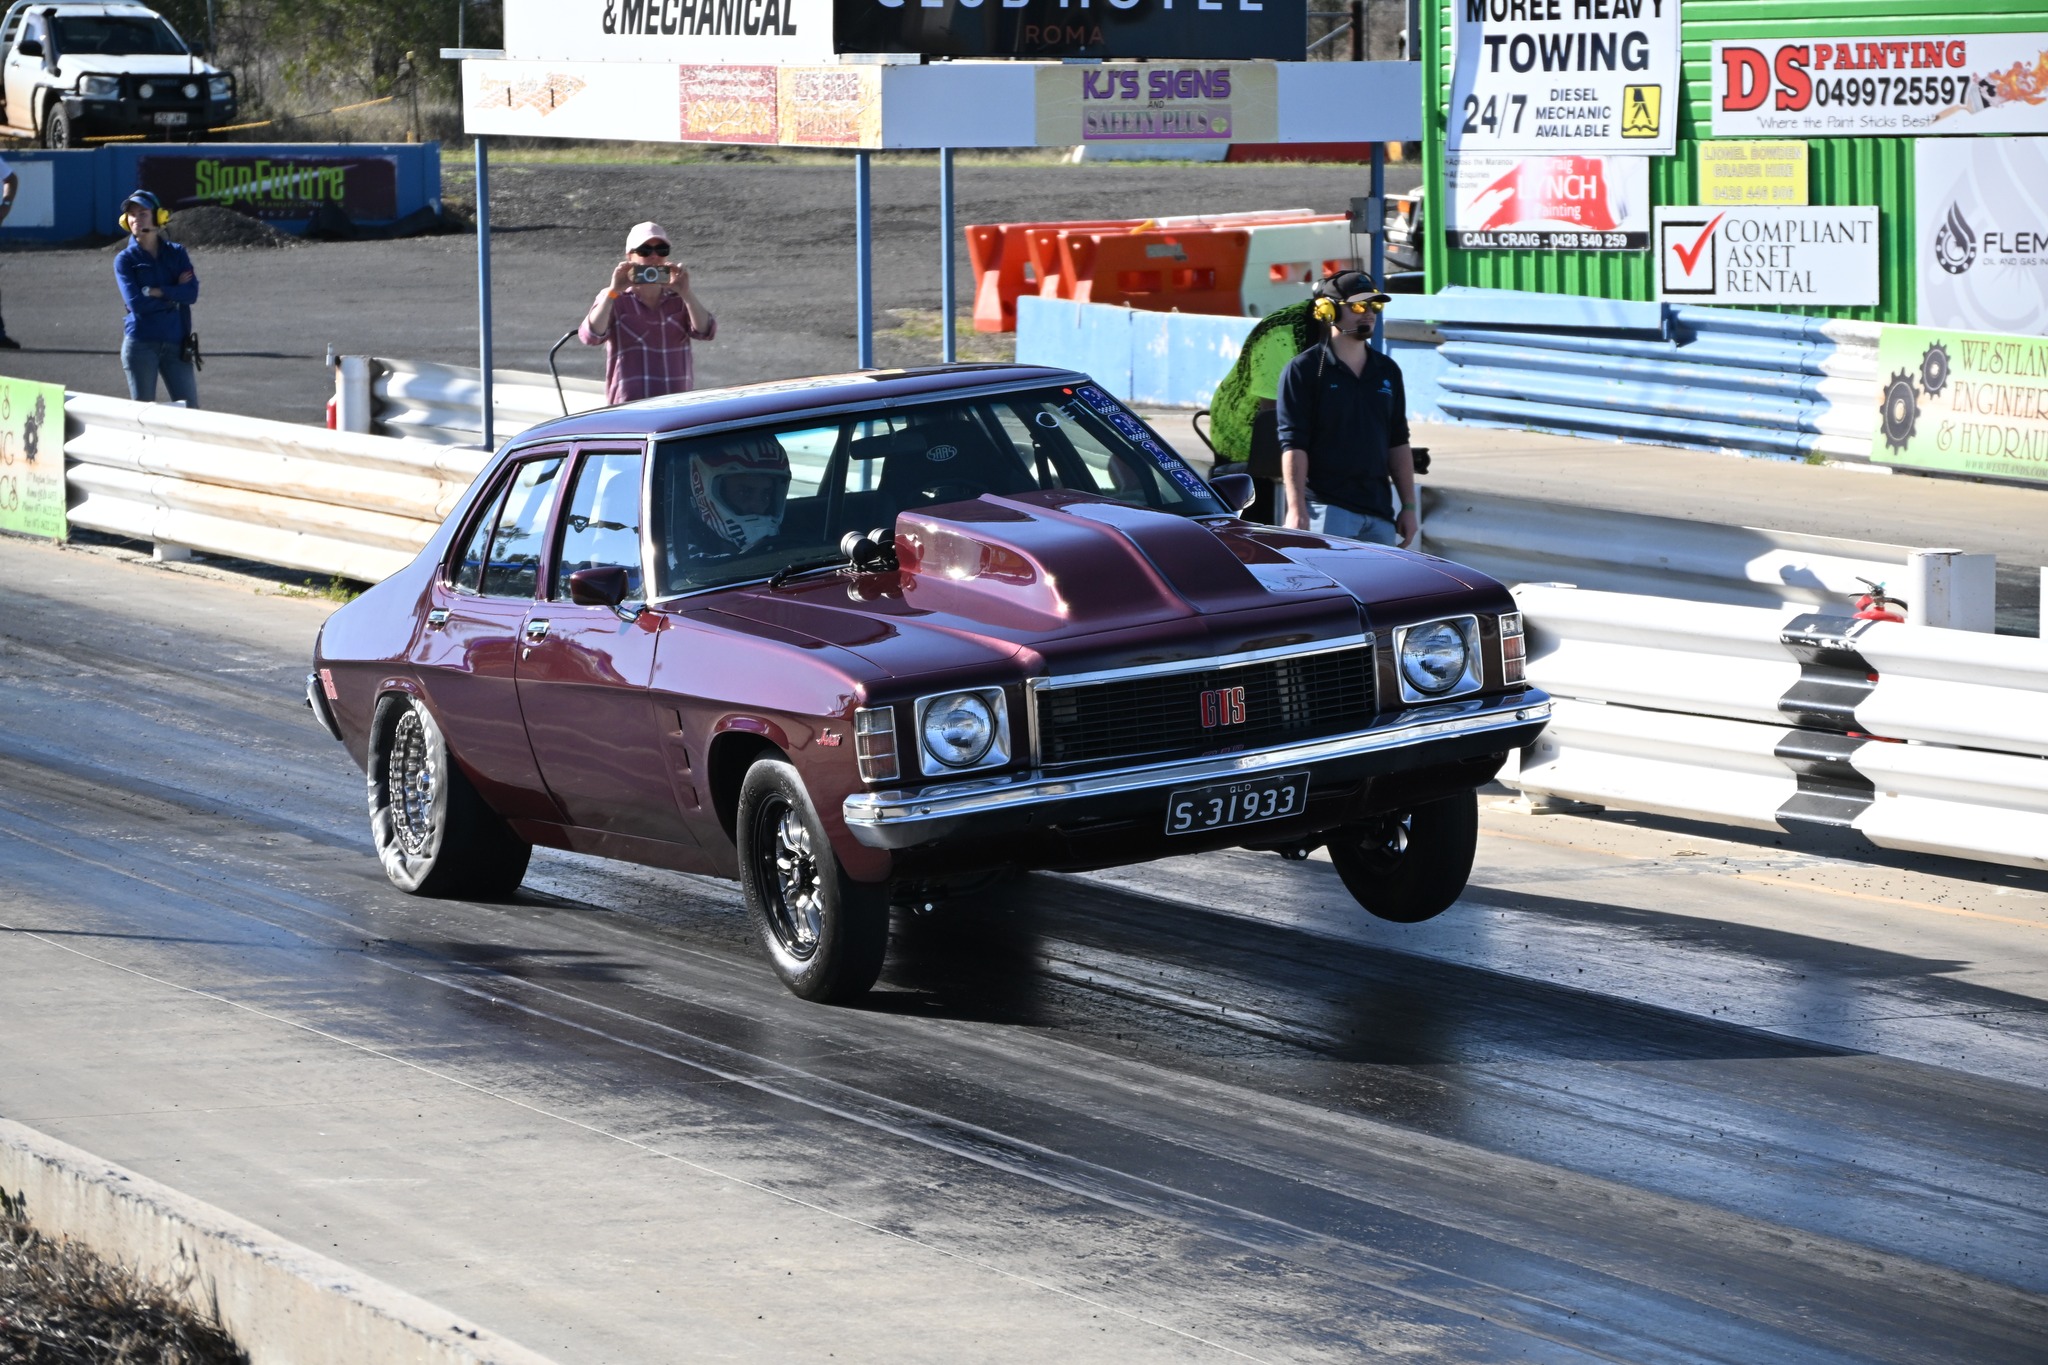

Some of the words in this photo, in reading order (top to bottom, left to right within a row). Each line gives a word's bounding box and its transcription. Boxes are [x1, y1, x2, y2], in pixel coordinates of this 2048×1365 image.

[602, 0, 617, 34] &
[620, 0, 798, 36] MECHANICAL
[1466, 0, 1561, 22] MOREE
[1574, 0, 1663, 20] HEAVY
[1025, 25, 1106, 45] ROMA
[1484, 31, 1649, 73] TOWING
[1083, 70, 1140, 99] KJ'S
[1148, 69, 1232, 99] SIGNS
[1722, 44, 1813, 112] DS
[1814, 41, 1967, 70] PAINTING
[1550, 88, 1599, 102] DIESEL
[1815, 76, 1971, 106] 0499725597
[1087, 110, 1157, 135] SAFETY
[1162, 110, 1208, 135] PLUS
[1462, 92, 1528, 139] 24/7
[1535, 106, 1611, 120] MECHANIC
[1803, 116, 1822, 128] the
[1827, 115, 1854, 128] Paint
[1860, 115, 1897, 128] Sticks
[1535, 124, 1610, 138] AVAILABLE
[1462, 232, 1496, 247] CALL
[1499, 232, 1540, 247] CRAIG
[1549, 233, 1579, 247] 0428
[1581, 233, 1602, 247] 540
[1604, 233, 1628, 247] 259
[1725, 219, 1873, 244] COMPLIANT
[1727, 244, 1796, 268] ASSET
[1727, 269, 1817, 293] RENTAL
[1936, 419, 1957, 451] &
[1960, 422, 2048, 462] HYDRAU
[926, 444, 957, 462] SAAS
[1200, 686, 1246, 728] GTS
[1229, 783, 1252, 794] QLD
